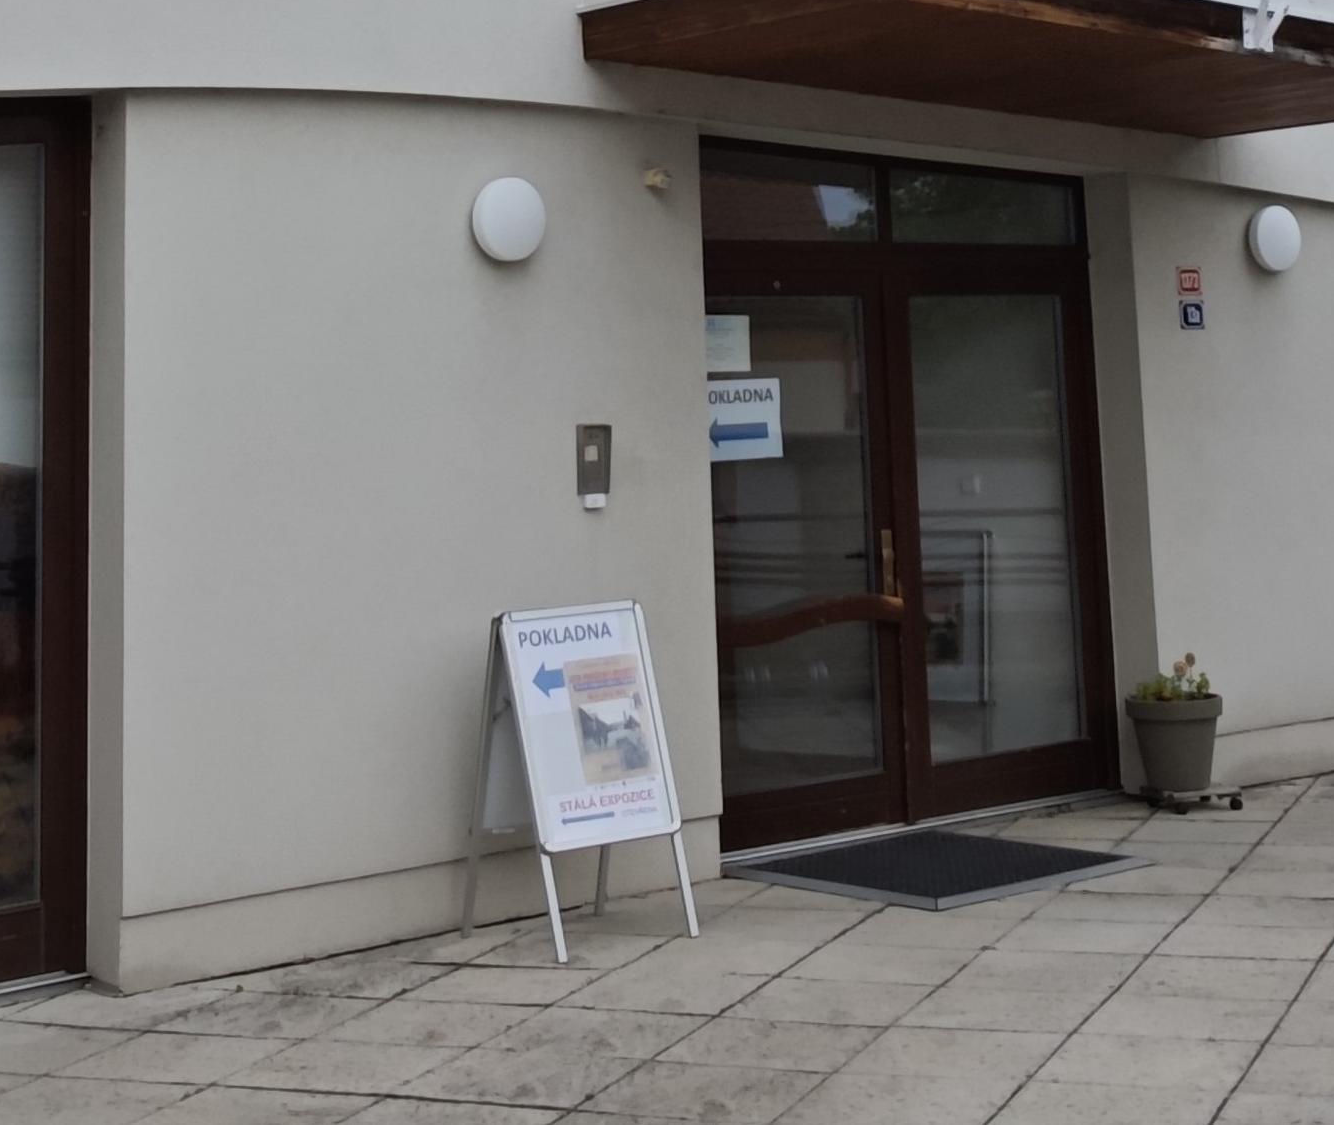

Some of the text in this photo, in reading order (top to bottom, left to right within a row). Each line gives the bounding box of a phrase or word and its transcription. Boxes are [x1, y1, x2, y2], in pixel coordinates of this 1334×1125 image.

[708, 388, 774, 405] OKLADNA
[518, 621, 612, 648] POKLADNA
[599, 788, 655, 808] EXPOZICE
